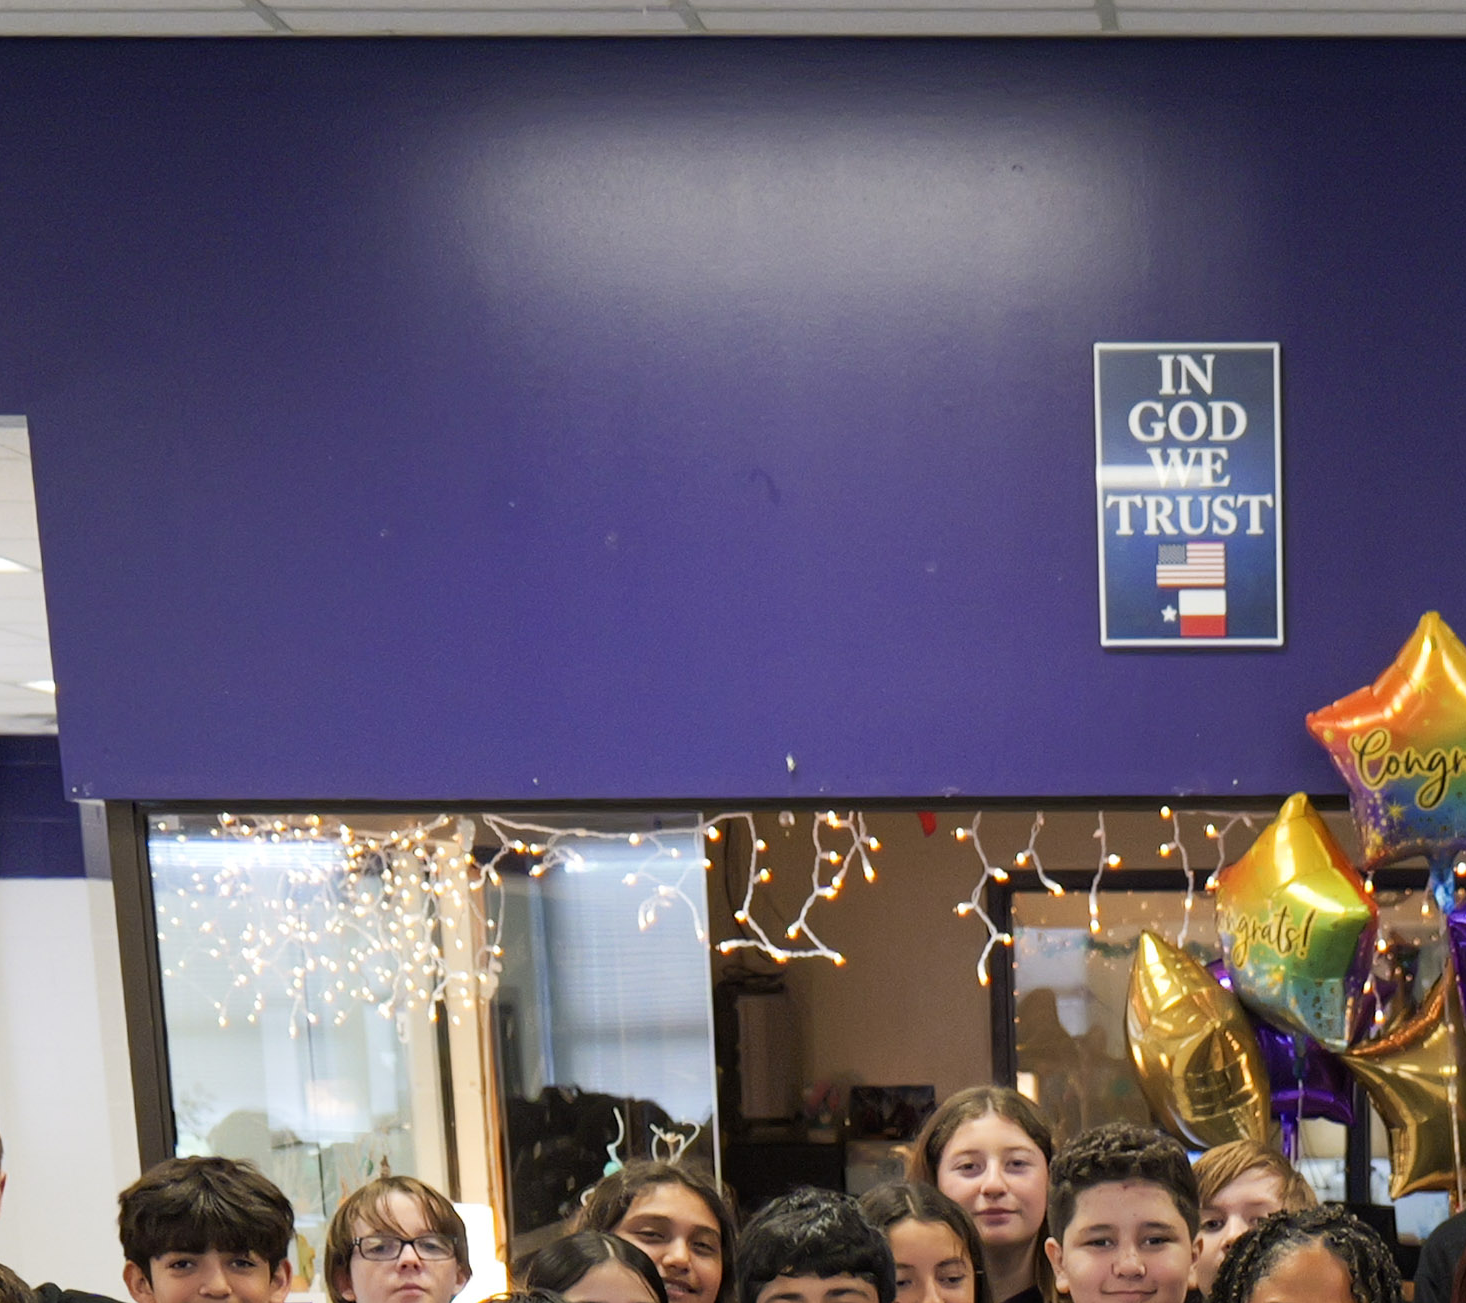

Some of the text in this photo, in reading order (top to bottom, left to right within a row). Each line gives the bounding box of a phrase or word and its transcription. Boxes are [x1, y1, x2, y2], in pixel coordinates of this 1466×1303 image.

[1158, 354, 1215, 395] IN
[1128, 401, 1247, 442] GOD
[1146, 447, 1230, 488] WE
[1105, 494, 1274, 536] TRUST
[1222, 904, 1316, 969] ngrats!
